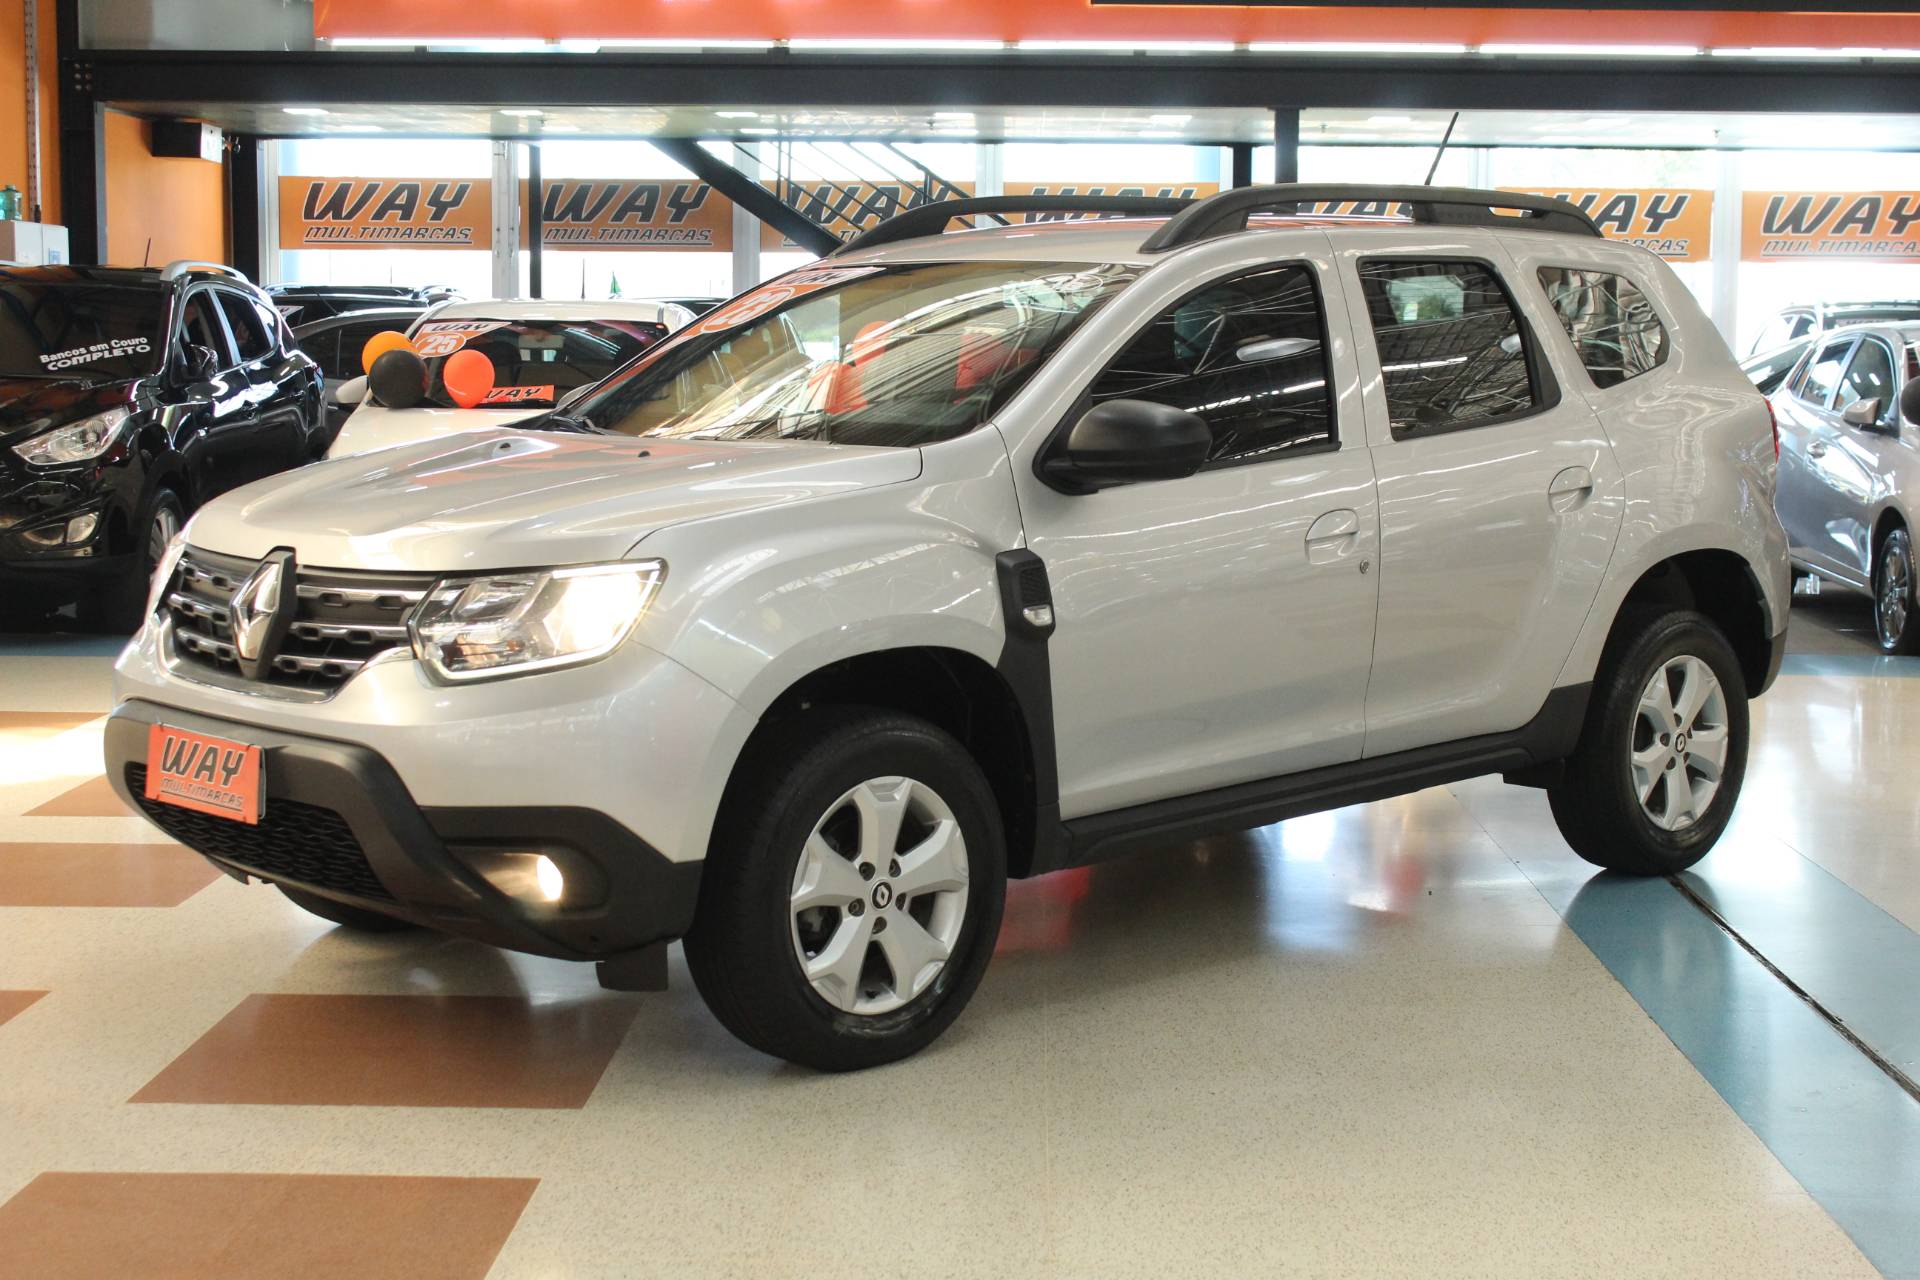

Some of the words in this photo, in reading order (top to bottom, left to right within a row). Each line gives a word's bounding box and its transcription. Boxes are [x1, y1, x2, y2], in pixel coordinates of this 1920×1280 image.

[303, 182, 471, 222] WAY
[543, 183, 712, 224] WAY
[1760, 195, 1920, 236] WAY
[304, 226, 473, 240] MULTIMARCAS
[544, 227, 713, 241] MULTIMARCAS
[1762, 240, 1920, 253] MULTIMARCA
[430, 323, 490, 332] WAY
[40, 347, 87, 363] Bancos
[89, 343, 110, 352] em
[111, 337, 148, 348] Couro
[47, 344, 151, 371] COMPLETO
[161, 735, 246, 788] WAY
[161, 778, 244, 807] MULTIMARCAS
